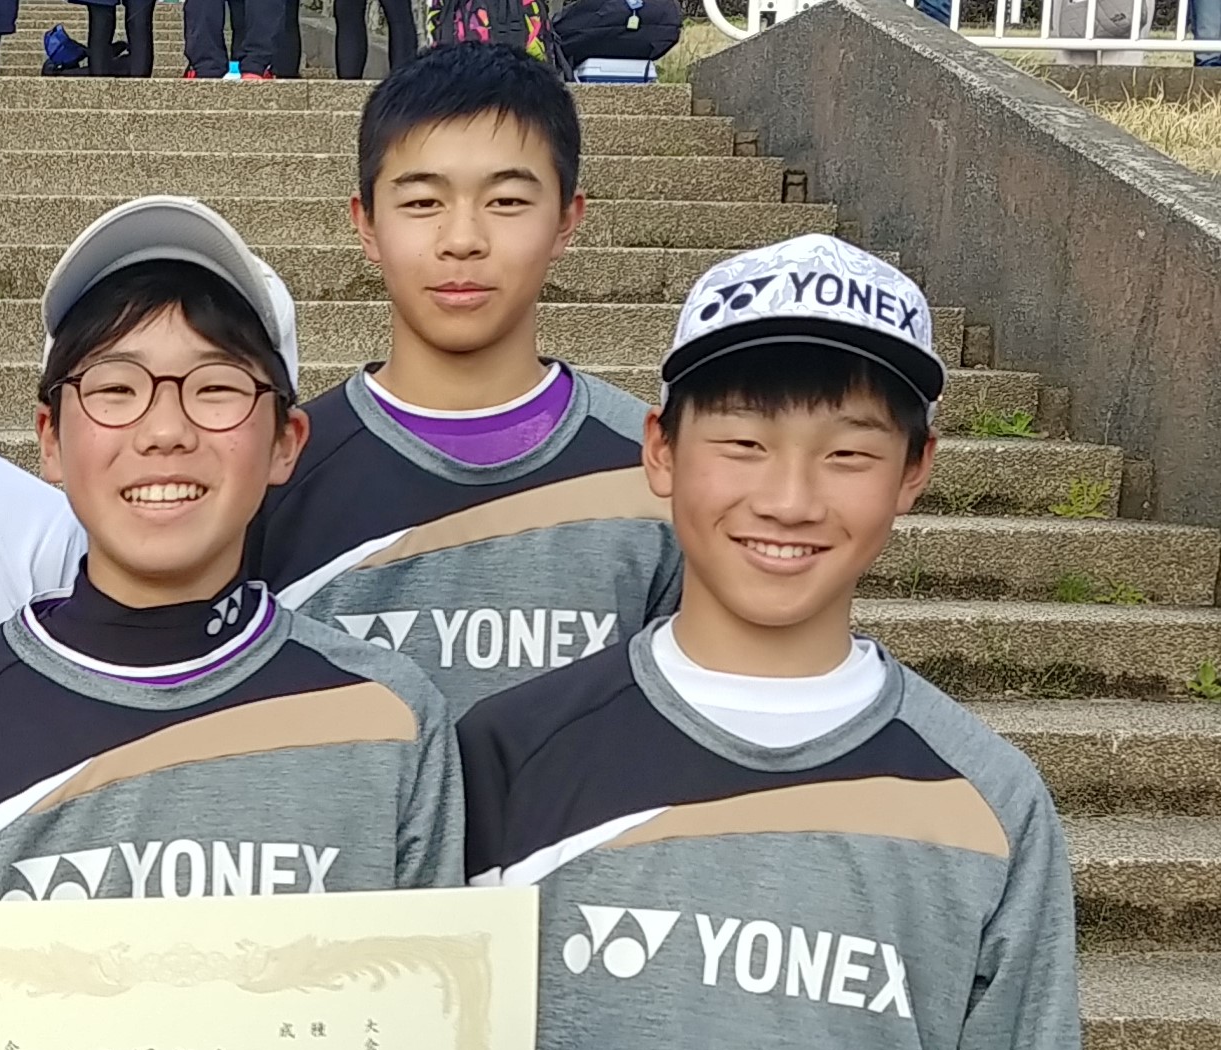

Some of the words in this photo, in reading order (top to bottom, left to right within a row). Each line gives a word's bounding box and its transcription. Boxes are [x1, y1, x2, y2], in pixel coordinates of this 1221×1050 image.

[789, 272, 918, 340] YONEX
[432, 608, 618, 669] YONEX
[118, 839, 341, 900] YONEX
[694, 913, 913, 1018] YONEX
